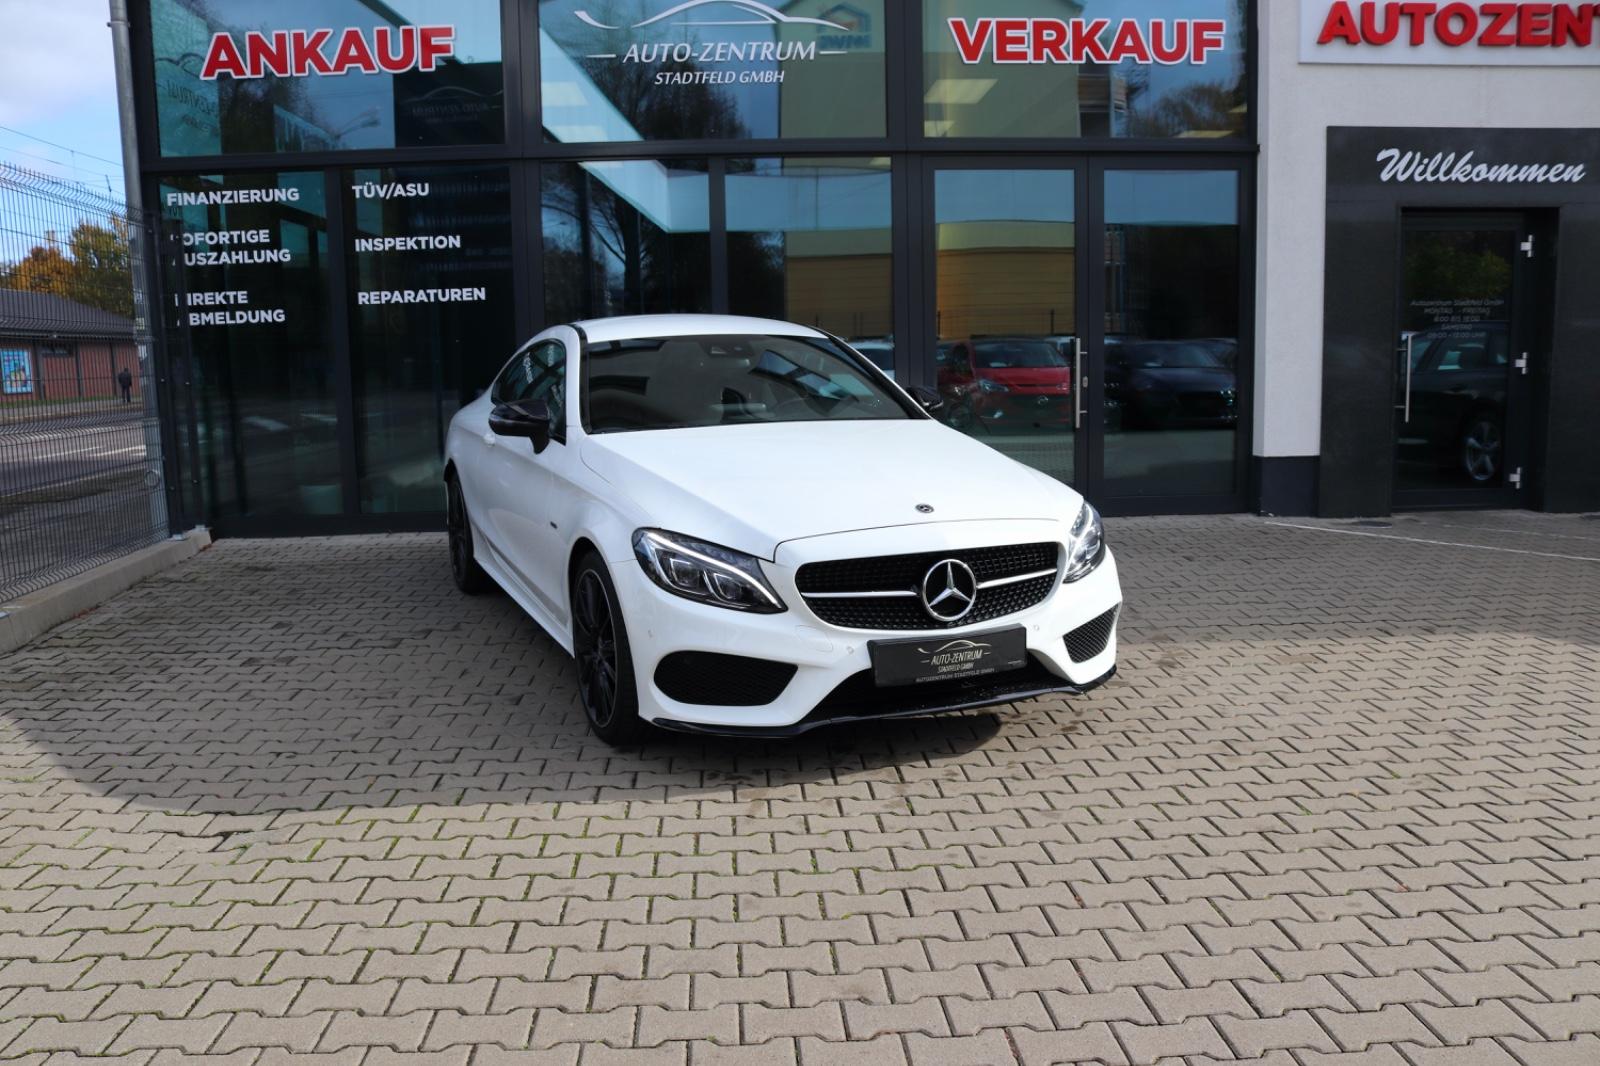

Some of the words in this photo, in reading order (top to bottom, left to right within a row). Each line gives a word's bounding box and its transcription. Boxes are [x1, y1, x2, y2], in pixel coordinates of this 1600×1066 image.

[1317, 1, 1600, 47] AUTOZEN
[948, 17, 1226, 64] VERKAUF
[200, 24, 456, 80] ANKAUF
[622, 41, 816, 63] AUTO-ZENTRUM
[654, 71, 736, 85] STADTFELD
[739, 70, 785, 84] GMBH
[1376, 148, 1586, 183] Willkommen
[167, 188, 300, 207] FINANZIERUNG
[352, 182, 430, 199] TÜV/ASU
[170, 229, 270, 247] OFORTIGE
[354, 235, 461, 252] INSPEKTION
[172, 249, 291, 267] USZAHLUNG
[175, 291, 248, 307] IREKTE
[357, 287, 486, 305] REPARATUREN
[177, 309, 286, 326] BMELDUNG
[931, 649, 983, 666] AUTO-ZENTRUM
